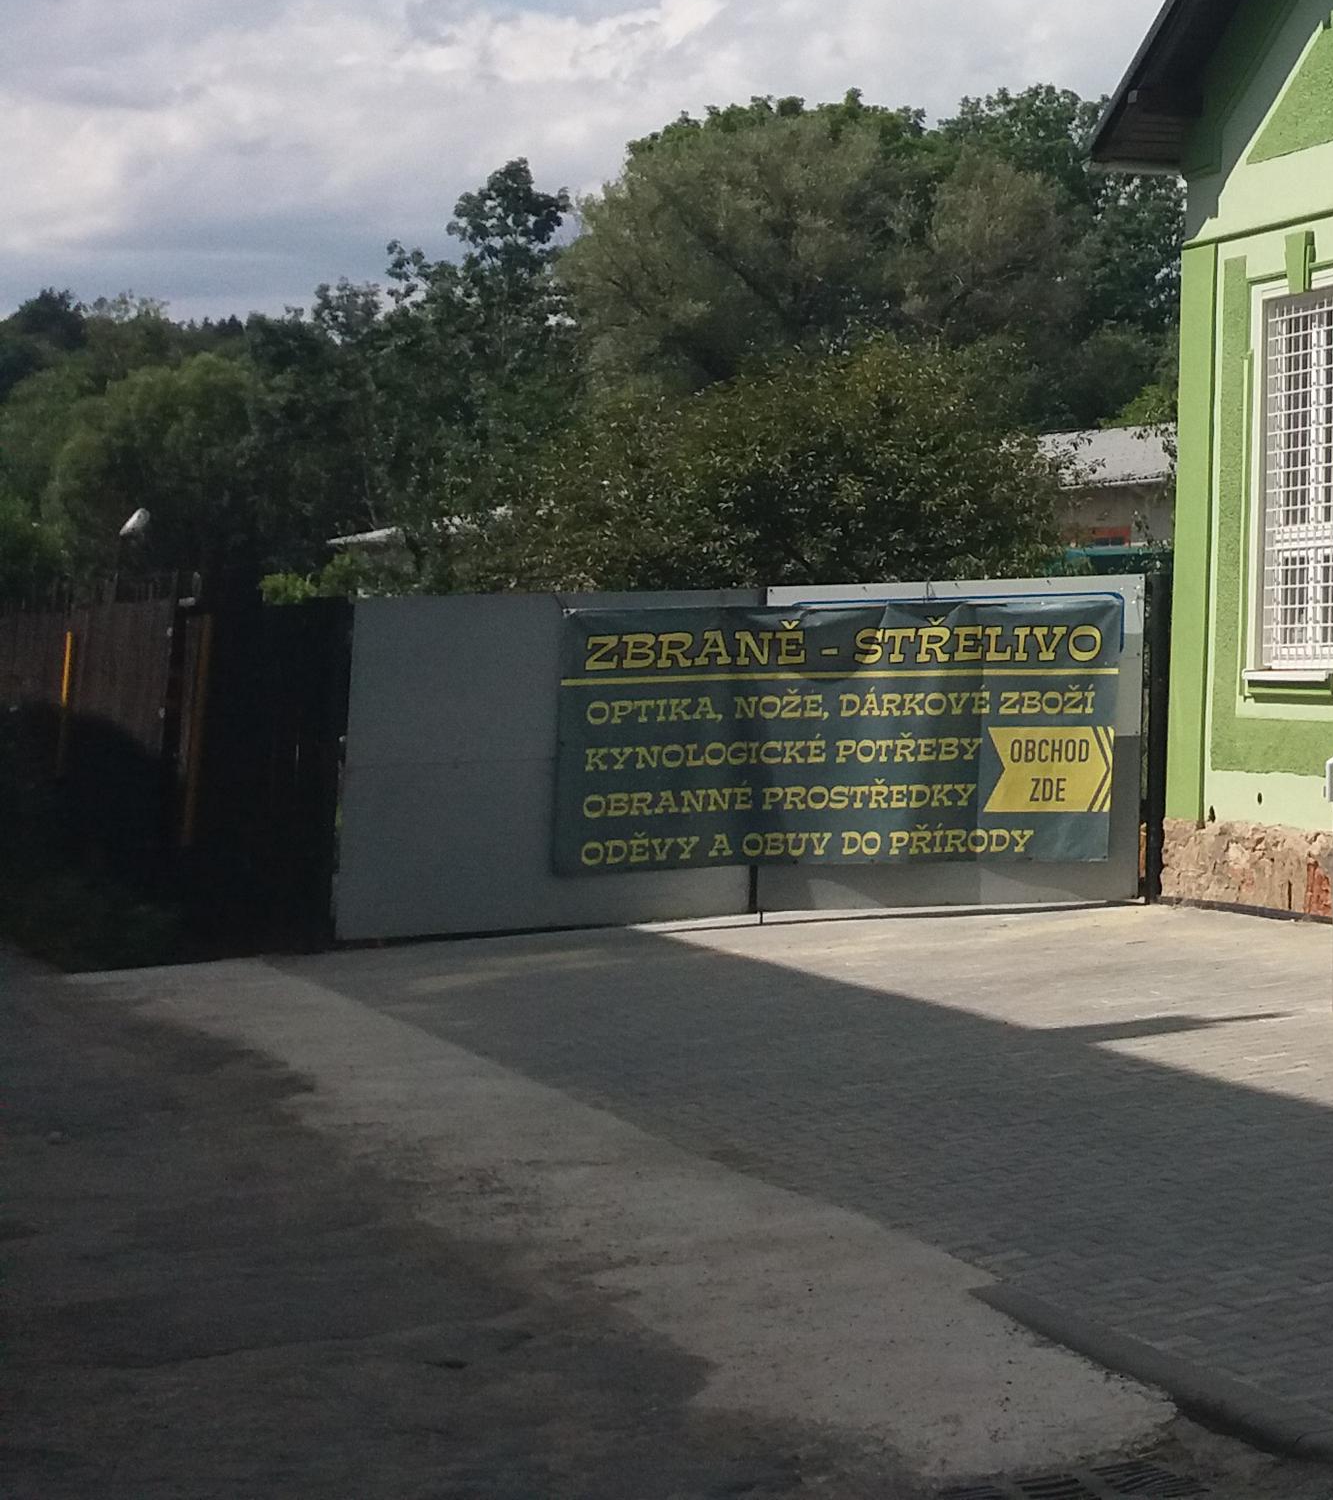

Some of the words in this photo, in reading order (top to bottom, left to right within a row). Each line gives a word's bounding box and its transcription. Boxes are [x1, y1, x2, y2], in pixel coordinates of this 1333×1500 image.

[585, 620, 806, 671] ZBRANĚ
[854, 616, 1102, 665] STŘELIVO
[586, 696, 723, 725] OPTIKA,
[735, 688, 829, 721] NOŽE,
[839, 685, 991, 717] DÁRKOVÉ
[999, 684, 1096, 715] ZBOŽÍ
[585, 733, 827, 772] KYNOLOGICKÉ
[836, 732, 983, 764] POTŘEBY
[1010, 739, 1090, 763] OBCHOD
[583, 780, 753, 818] OBRANNÉ
[762, 778, 976, 811] PROSTŘEDKY
[1029, 778, 1067, 802] ZDE
[581, 832, 700, 866] ODĚVY
[708, 833, 734, 857] A
[742, 832, 832, 857] OBUV
[841, 831, 881, 856] DO
[888, 824, 1034, 856] PŘÍRODY
